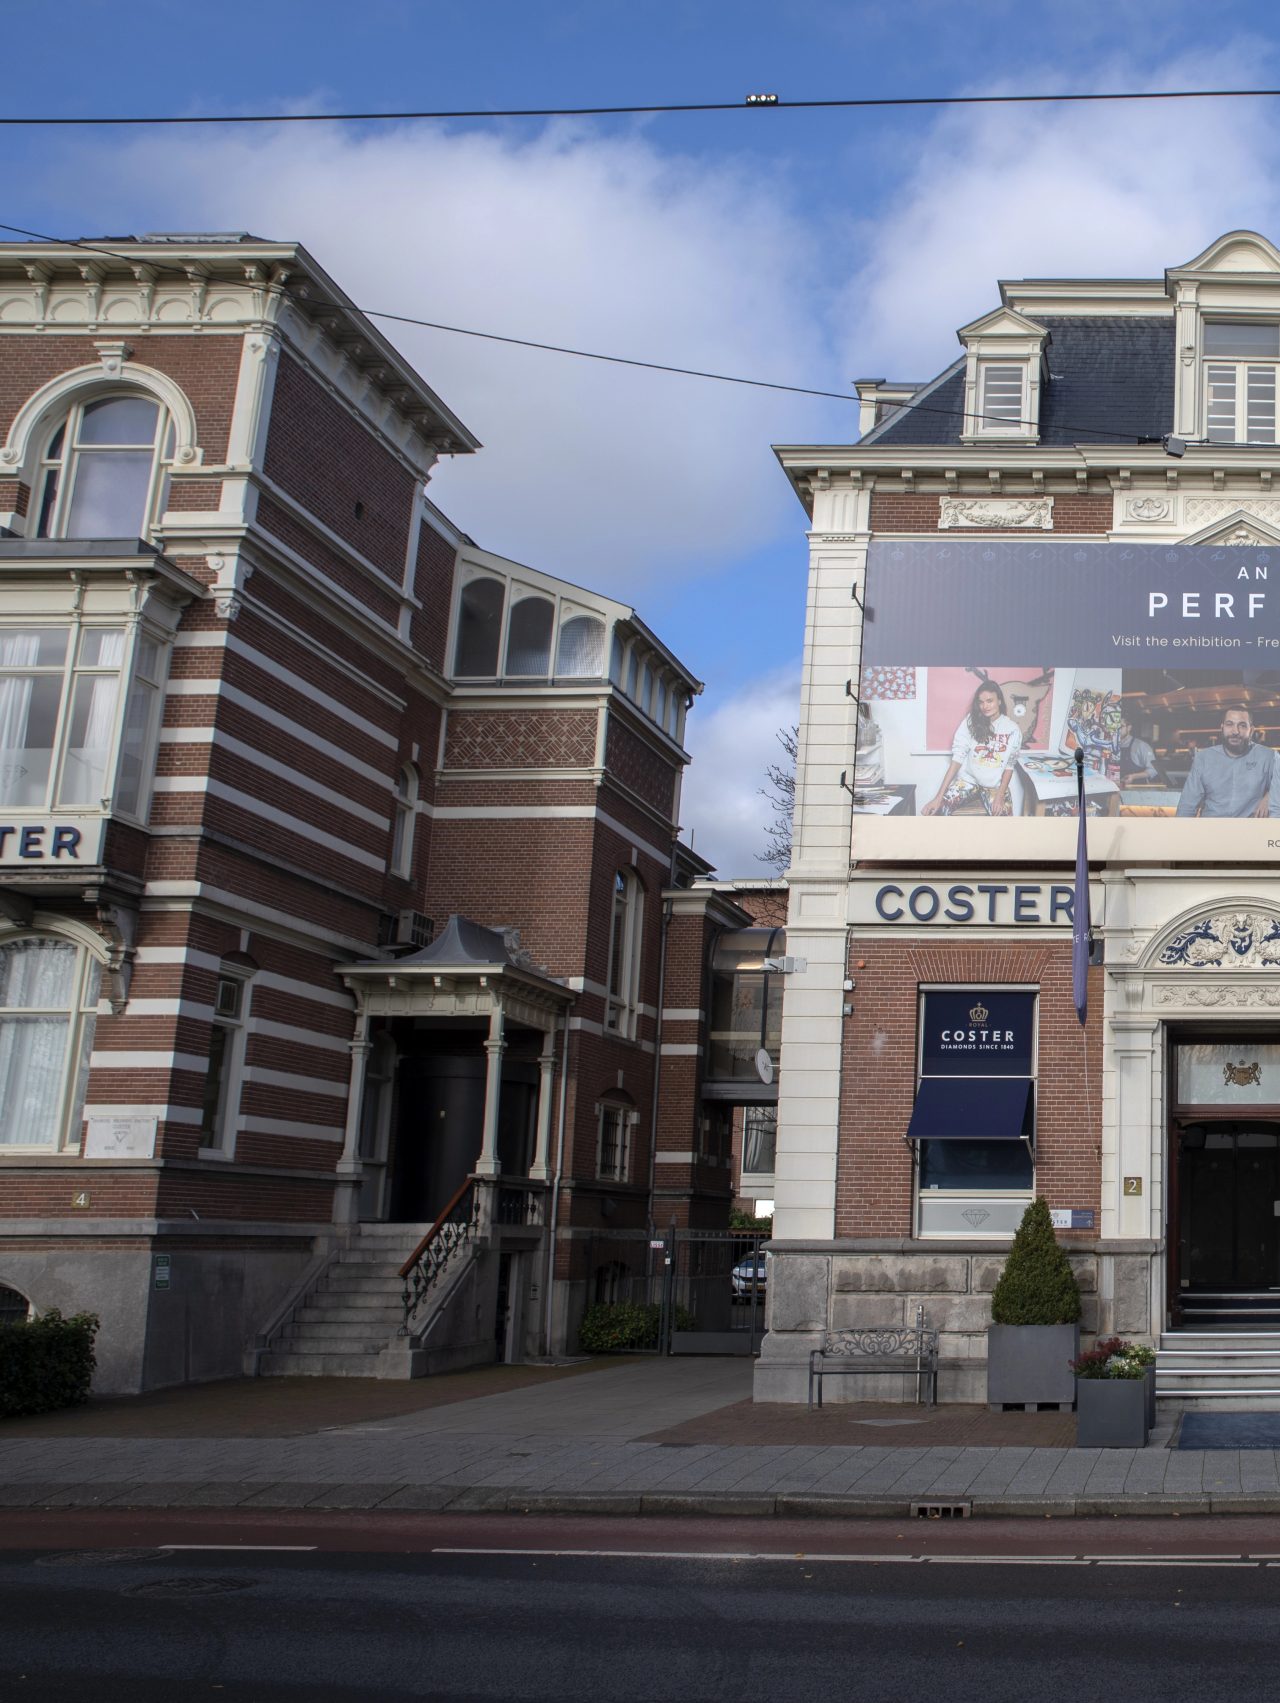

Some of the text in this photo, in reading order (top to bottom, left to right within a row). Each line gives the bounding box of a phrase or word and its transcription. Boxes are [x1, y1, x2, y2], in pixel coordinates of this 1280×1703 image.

[1237, 566, 1269, 581] AN
[1112, 635, 1141, 647] Visit
[1145, 635, 1169, 647] the
[1172, 635, 1241, 648] exhibition
[0, 825, 81, 859] TER
[875, 884, 1075, 922] COSTER
[941, 1030, 1014, 1042] COSTER
[1128, 1179, 1137, 1193] 2
[76, 1192, 86, 1206] 4
